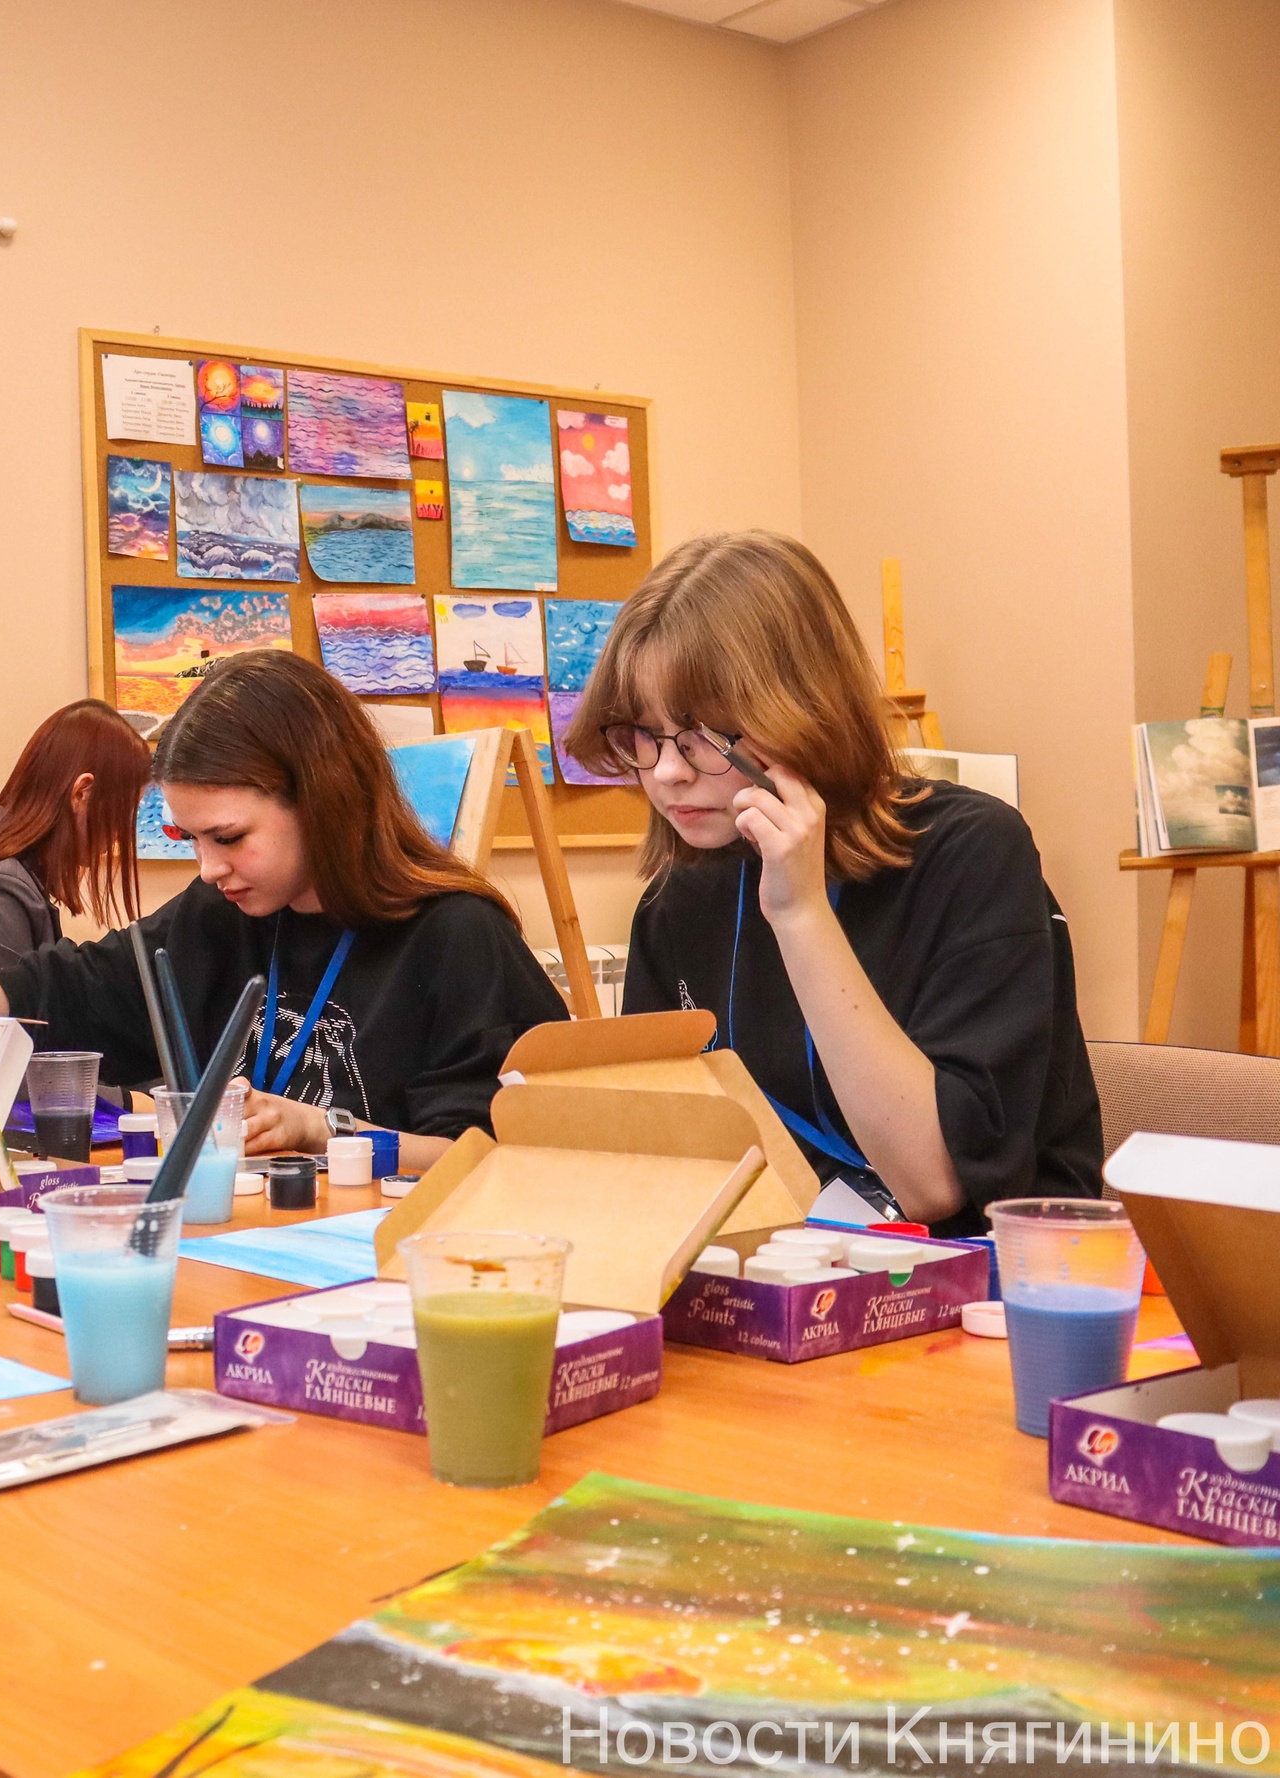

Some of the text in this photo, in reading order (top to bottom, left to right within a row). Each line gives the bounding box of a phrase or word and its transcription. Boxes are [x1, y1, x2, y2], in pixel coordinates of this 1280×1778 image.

[39, 1175, 60, 1190] gloss
[702, 1279, 730, 1297] gloss
[688, 1298, 736, 1326] Paints
[723, 1297, 755, 1311] artistic
[864, 1296, 914, 1320] Краски
[937, 1304, 949, 1318] 12
[802, 1322, 840, 1341] АКРИЛ
[862, 1309, 926, 1335] ГЛЯНЦЕВЫЕ
[738, 1331, 780, 1350] 12 colours
[225, 1363, 273, 1384] АКРИЛ
[304, 1358, 373, 1394] Краски
[305, 1383, 397, 1415] ГЛЯНЦЕВЫЕ
[1065, 1463, 1130, 1494] АКРИЛ
[1209, 1472, 1280, 1500] художеств
[1177, 1467, 1277, 1517] Краски
[1177, 1498, 1280, 1541] ГЛЯНЦЕВ
